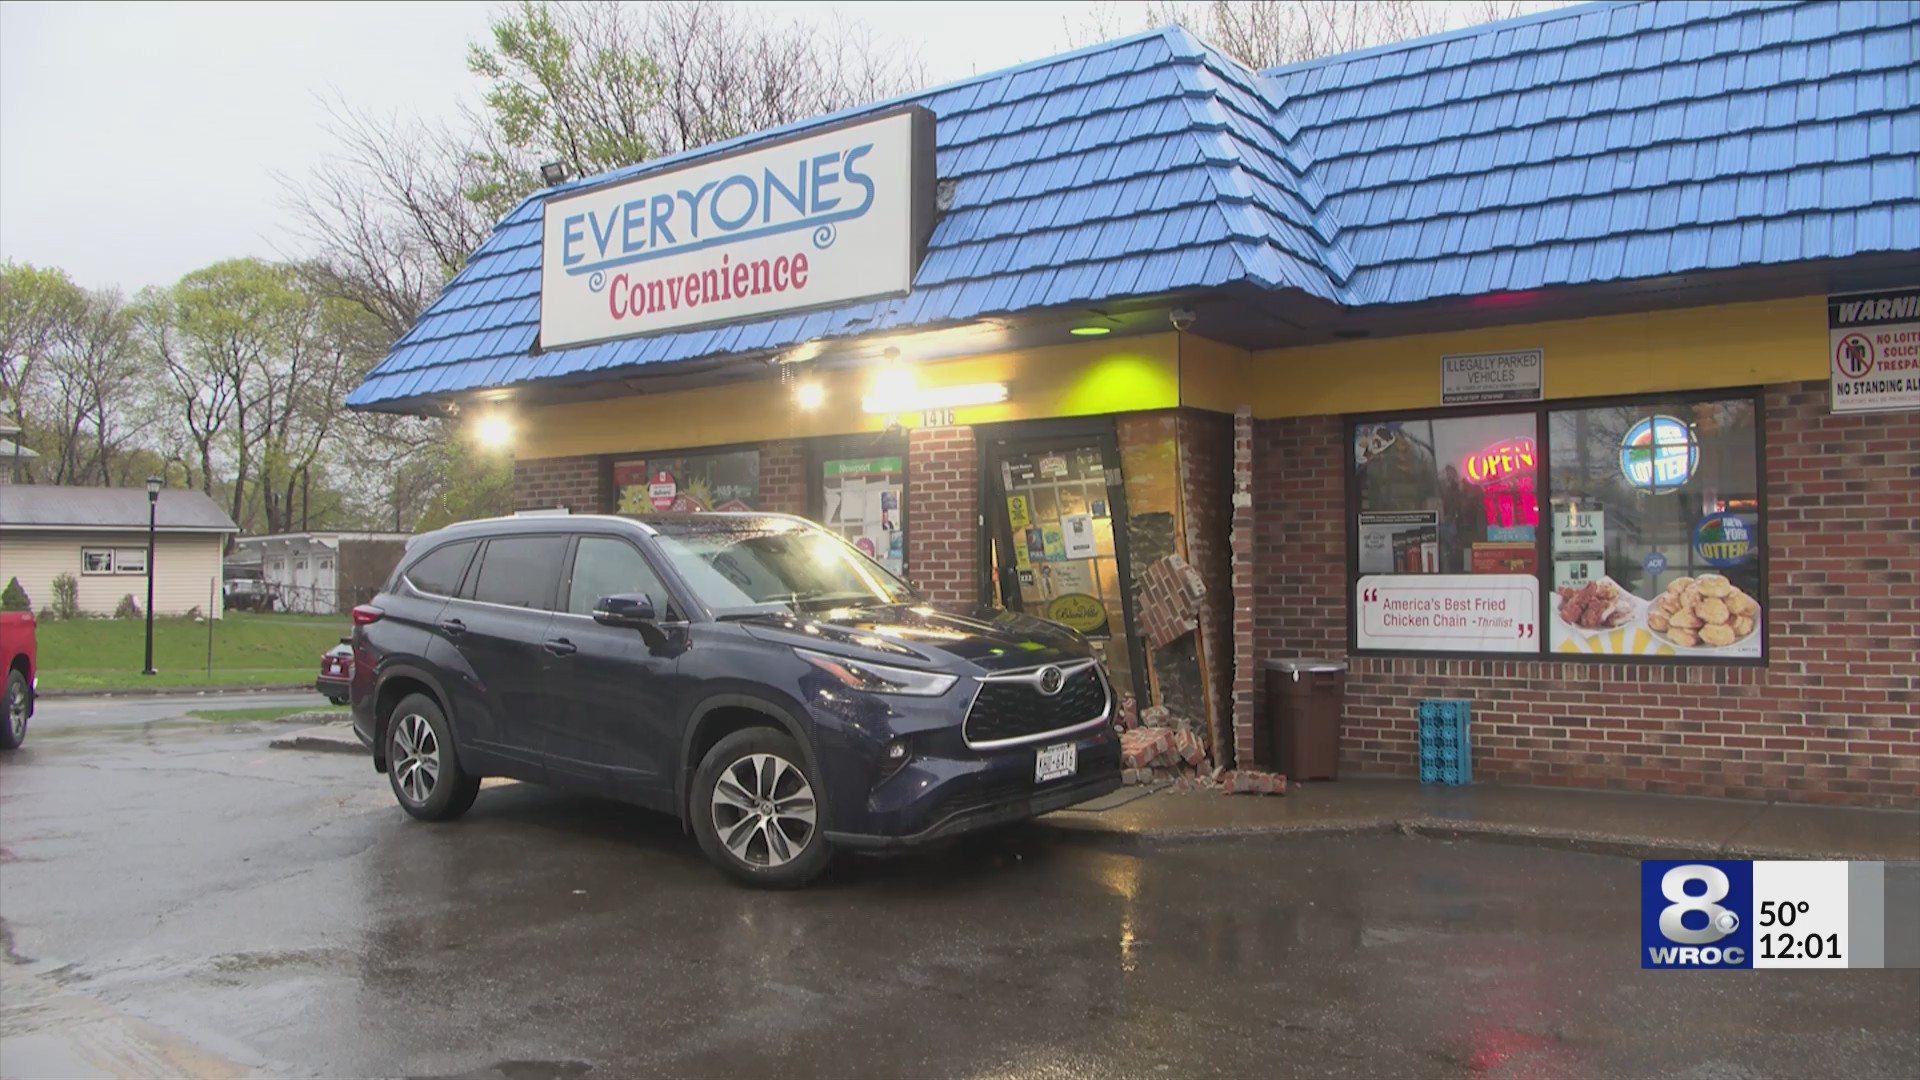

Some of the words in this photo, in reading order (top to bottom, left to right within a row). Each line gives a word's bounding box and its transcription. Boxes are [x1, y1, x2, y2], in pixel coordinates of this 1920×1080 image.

[563, 143, 875, 266] EVERYONE'S
[609, 252, 809, 321] Convenience
[1838, 295, 1920, 322] WARNI
[1876, 334, 1891, 344] NO
[1446, 359, 1496, 372] ILLEGALLY
[1498, 354, 1537, 369] PARKED
[1877, 358, 1920, 371] TRESPA
[1467, 369, 1515, 384] VEHICLES
[1837, 383, 1851, 395] NO
[1853, 379, 1903, 394] STANDING
[923, 408, 954, 427] 1416
[840, 463, 871, 473] Newport
[1468, 442, 1533, 480] OPEN
[1722, 517, 1743, 527] NEW
[1724, 528, 1748, 541] YORK
[1699, 541, 1749, 559] LOTTERY
[1383, 599, 1441, 611] America's
[1444, 599, 1471, 611] Best
[1475, 599, 1506, 611] Fried
[1383, 614, 1429, 627] Chicken
[1433, 614, 1467, 627] Chain
